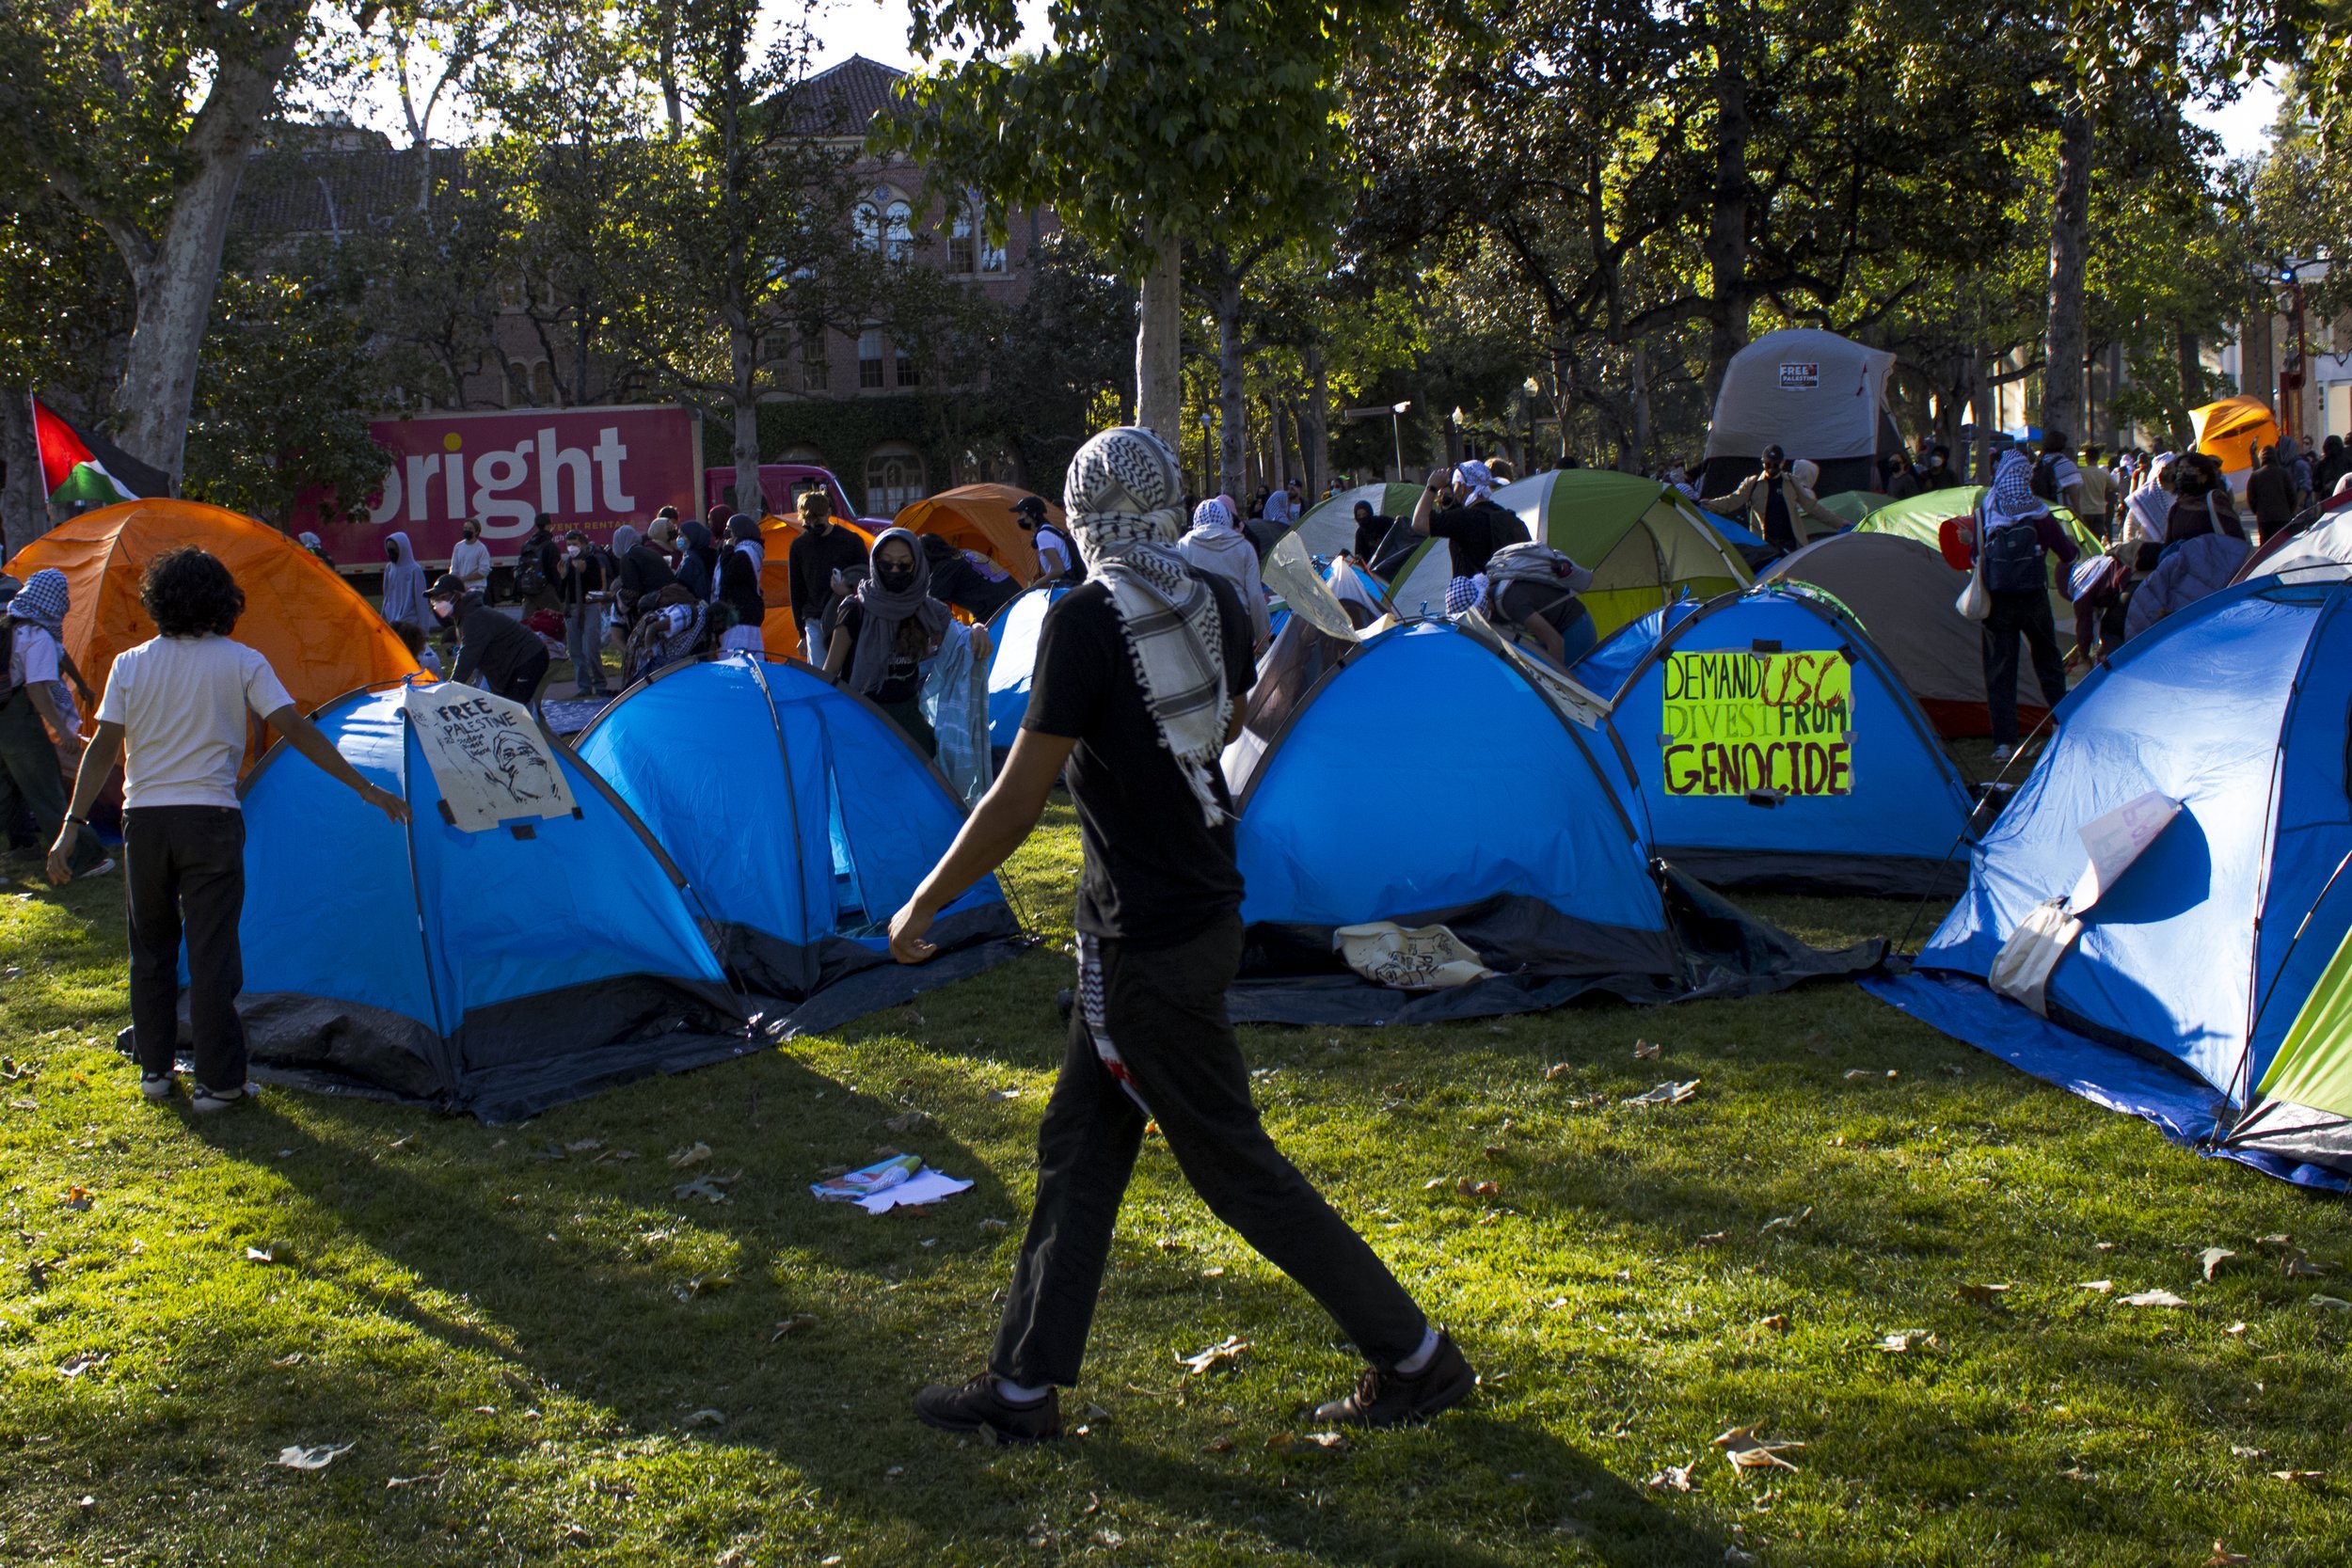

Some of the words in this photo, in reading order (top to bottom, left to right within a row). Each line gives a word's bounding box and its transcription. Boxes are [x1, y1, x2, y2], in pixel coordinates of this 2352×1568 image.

[1780, 366, 1809, 375] FREE
[549, 522, 580, 531] VENT
[1664, 653, 1762, 701] DEMAND
[1760, 654, 1845, 709] USC
[437, 697, 493, 722] FREE
[1666, 704, 1773, 740] DIVEST
[1779, 699, 1848, 736] FROM
[443, 711, 516, 737] PALESTINE
[1663, 741, 1850, 796] GENOCIDE
